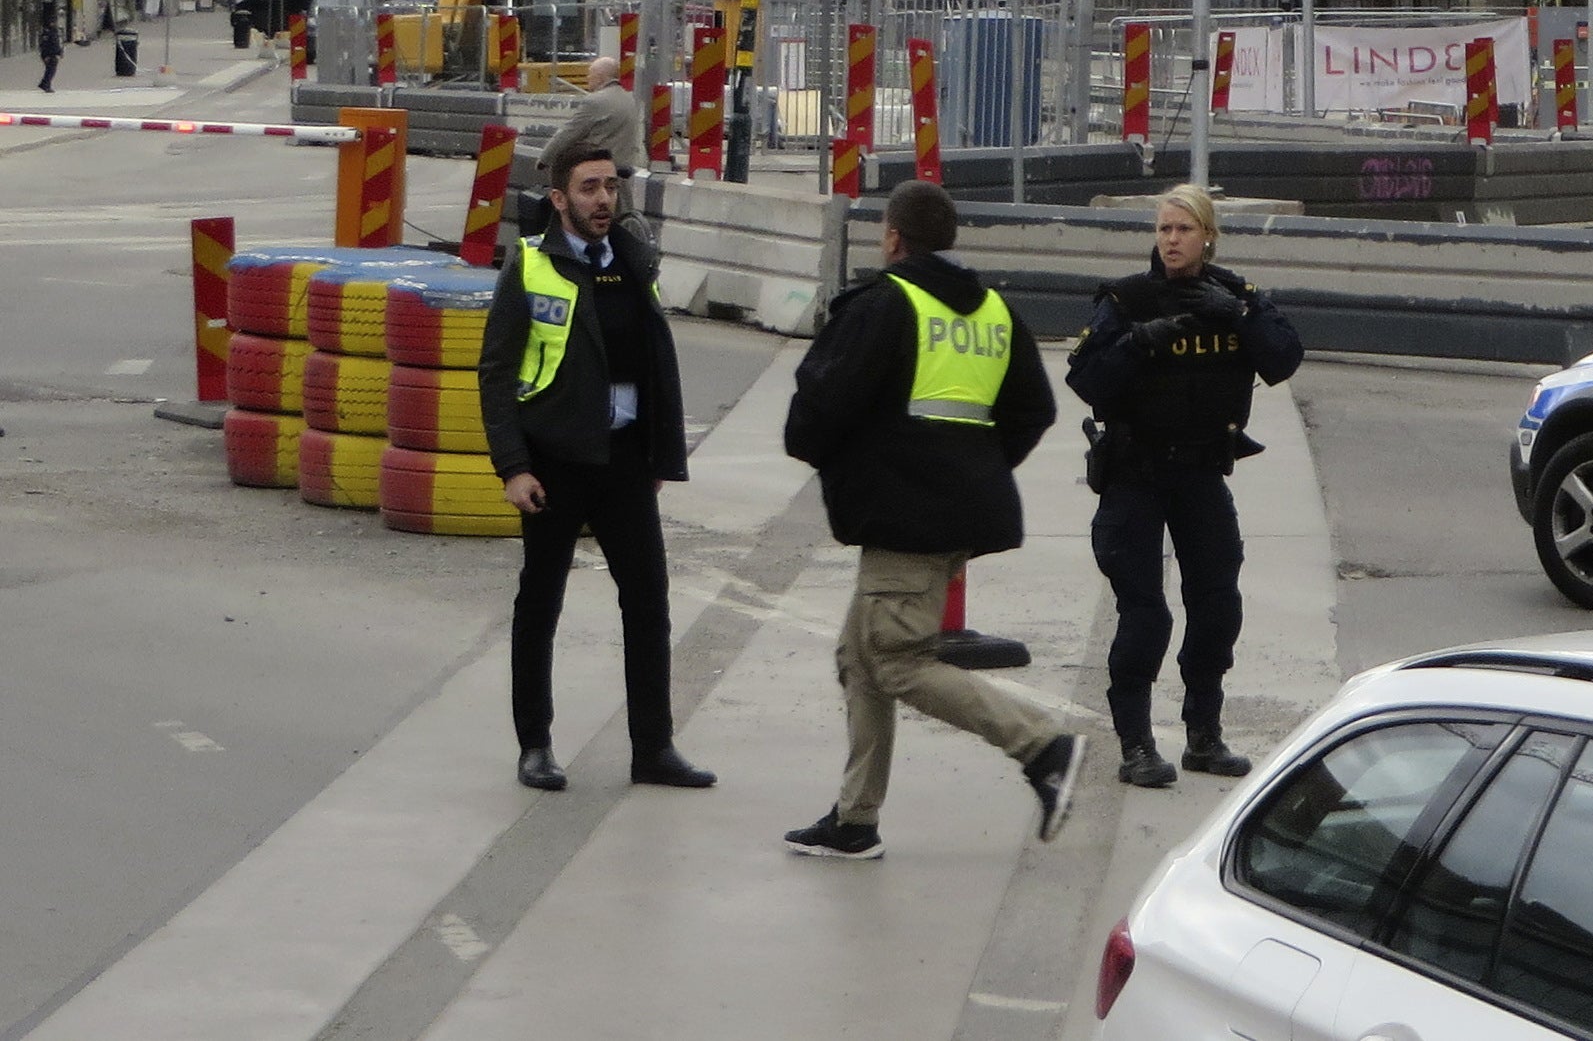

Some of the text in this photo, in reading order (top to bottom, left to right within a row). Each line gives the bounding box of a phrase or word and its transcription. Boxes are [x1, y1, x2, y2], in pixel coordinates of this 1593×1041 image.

[1233, 46, 1260, 76] NDEX
[1324, 43, 1463, 76] LINDE
[532, 296, 569, 324] PO
[927, 316, 1009, 360] POLIS
[1171, 333, 1240, 356] OLIS
